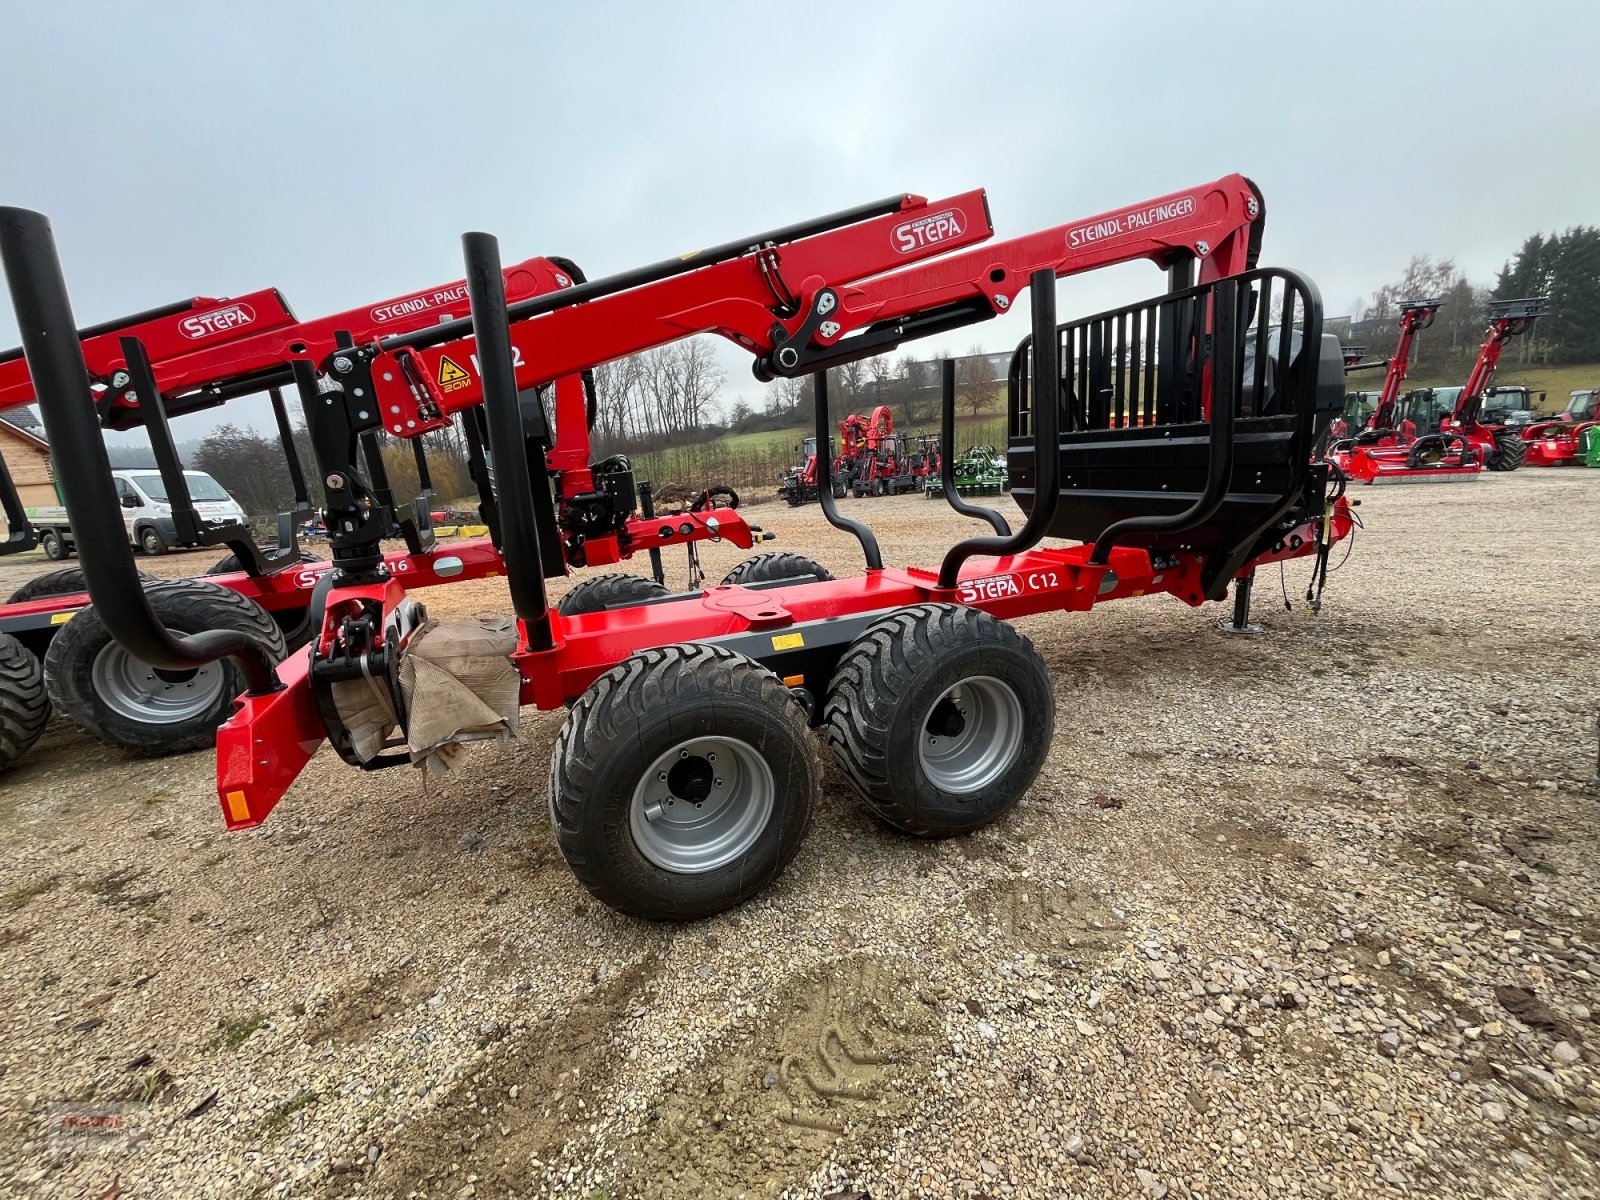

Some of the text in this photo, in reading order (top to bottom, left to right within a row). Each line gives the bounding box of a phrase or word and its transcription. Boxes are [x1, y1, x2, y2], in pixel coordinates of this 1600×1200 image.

[896, 216, 962, 252] STEPA
[1069, 198, 1193, 247] STEINDL-PALFINGER
[374, 285, 470, 321] STEINDL-PALFI
[183, 310, 252, 338] STEPA
[443, 378, 472, 393] 20M
[959, 579, 1019, 602] STEPA
[1028, 572, 1058, 590] C12
